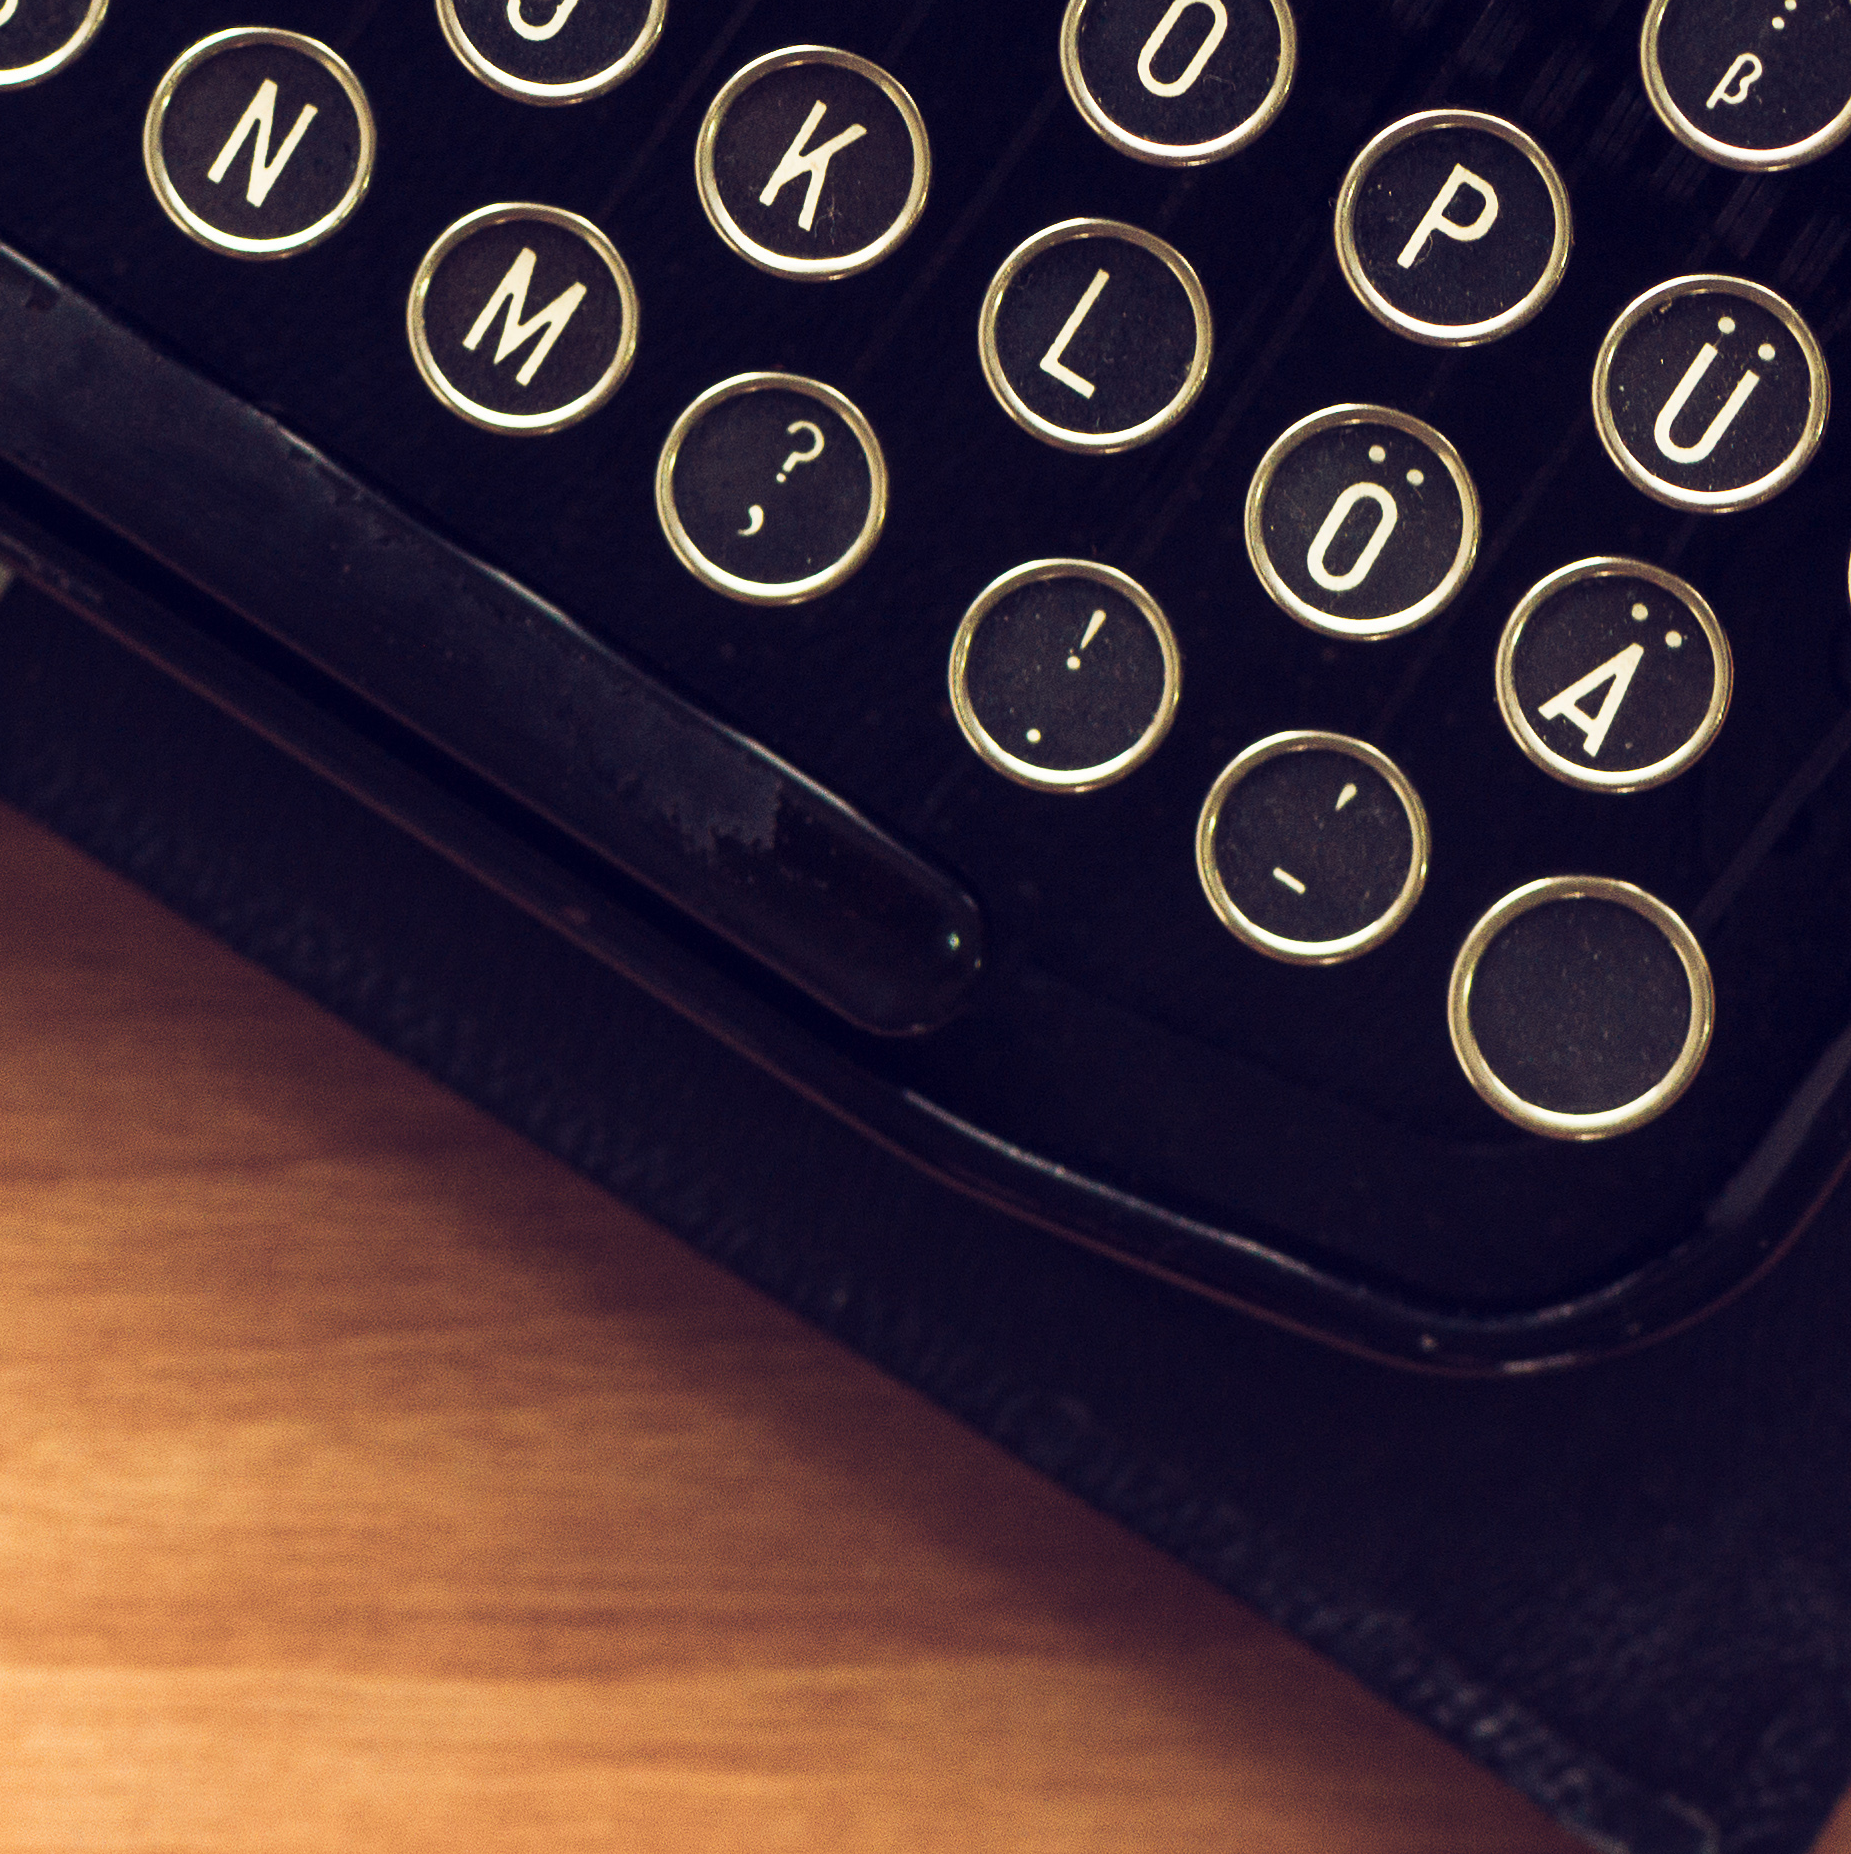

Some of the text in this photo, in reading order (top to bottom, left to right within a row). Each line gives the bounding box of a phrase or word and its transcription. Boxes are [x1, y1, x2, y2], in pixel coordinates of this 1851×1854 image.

[206, 77, 320, 209] N
[757, 98, 869, 233] K
[1395, 161, 1500, 271] P
[461, 246, 588, 388] M
[1038, 267, 1111, 401] L
[774, 419, 826, 484] ?
[1652, 315, 1777, 466] Ü
[1305, 444, 1426, 594] Ö
[1065, 608, 1108, 672] !
[1536, 602, 1684, 759] Ä
